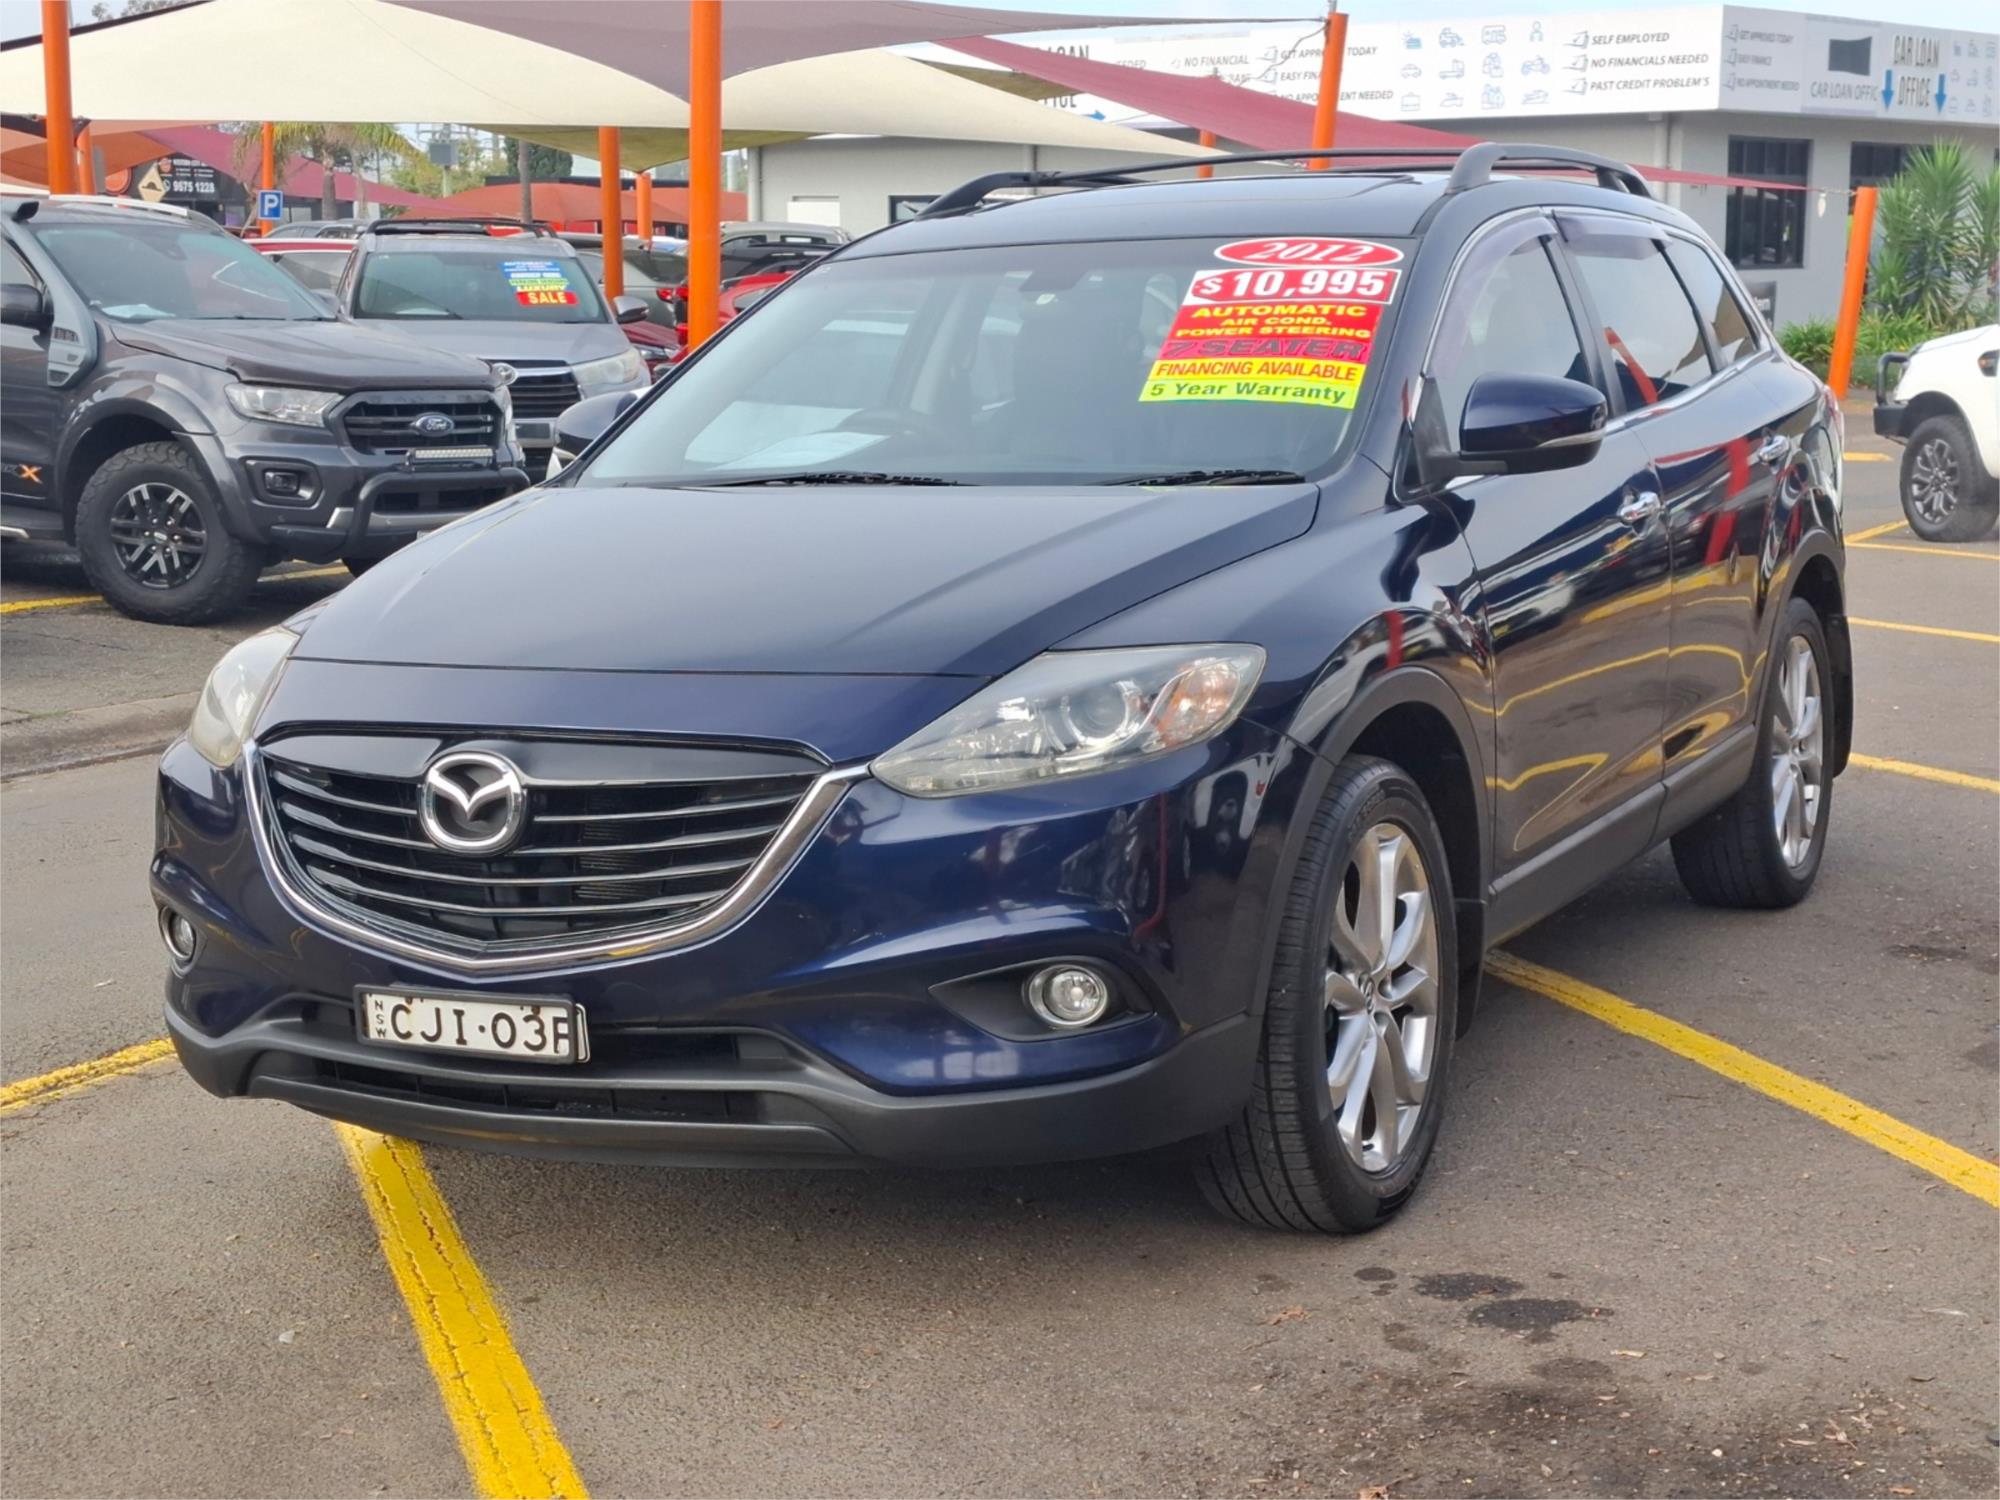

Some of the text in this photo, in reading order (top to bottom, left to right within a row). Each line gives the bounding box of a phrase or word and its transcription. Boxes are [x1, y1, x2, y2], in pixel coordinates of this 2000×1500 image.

[1592, 32, 1670, 45] SELF EMPLOYED
[1347, 46, 1377, 56] TODAY
[1894, 35, 1939, 67] CAR LOAN
[1185, 55, 1250, 68] NO FINANCIAL
[1591, 53, 1709, 68] NO FINANCIALS NEEDED
[1280, 71, 1301, 81] EASY
[1590, 77, 1710, 91] PAST CREDIT PROBLEM'S
[1810, 81, 1829, 98] CAR
[1830, 81, 1852, 100] LOAN
[1898, 76, 1931, 106] OFFICE
[1358, 90, 1393, 100] NEEDED
[264, 194, 279, 216] P
[1244, 242, 1374, 262] 2012
[527, 291, 567, 304] SALE
[1191, 304, 1368, 318] AUTOMATIC
[1220, 316, 1332, 327] AIR COND.
[1176, 326, 1371, 339] POWER STEERING
[1161, 339, 1366, 361] 7 SEATER
[1156, 361, 1359, 382] FINANCING AVAILABLE
[1150, 382, 1346, 405] 5 Year Warranty
